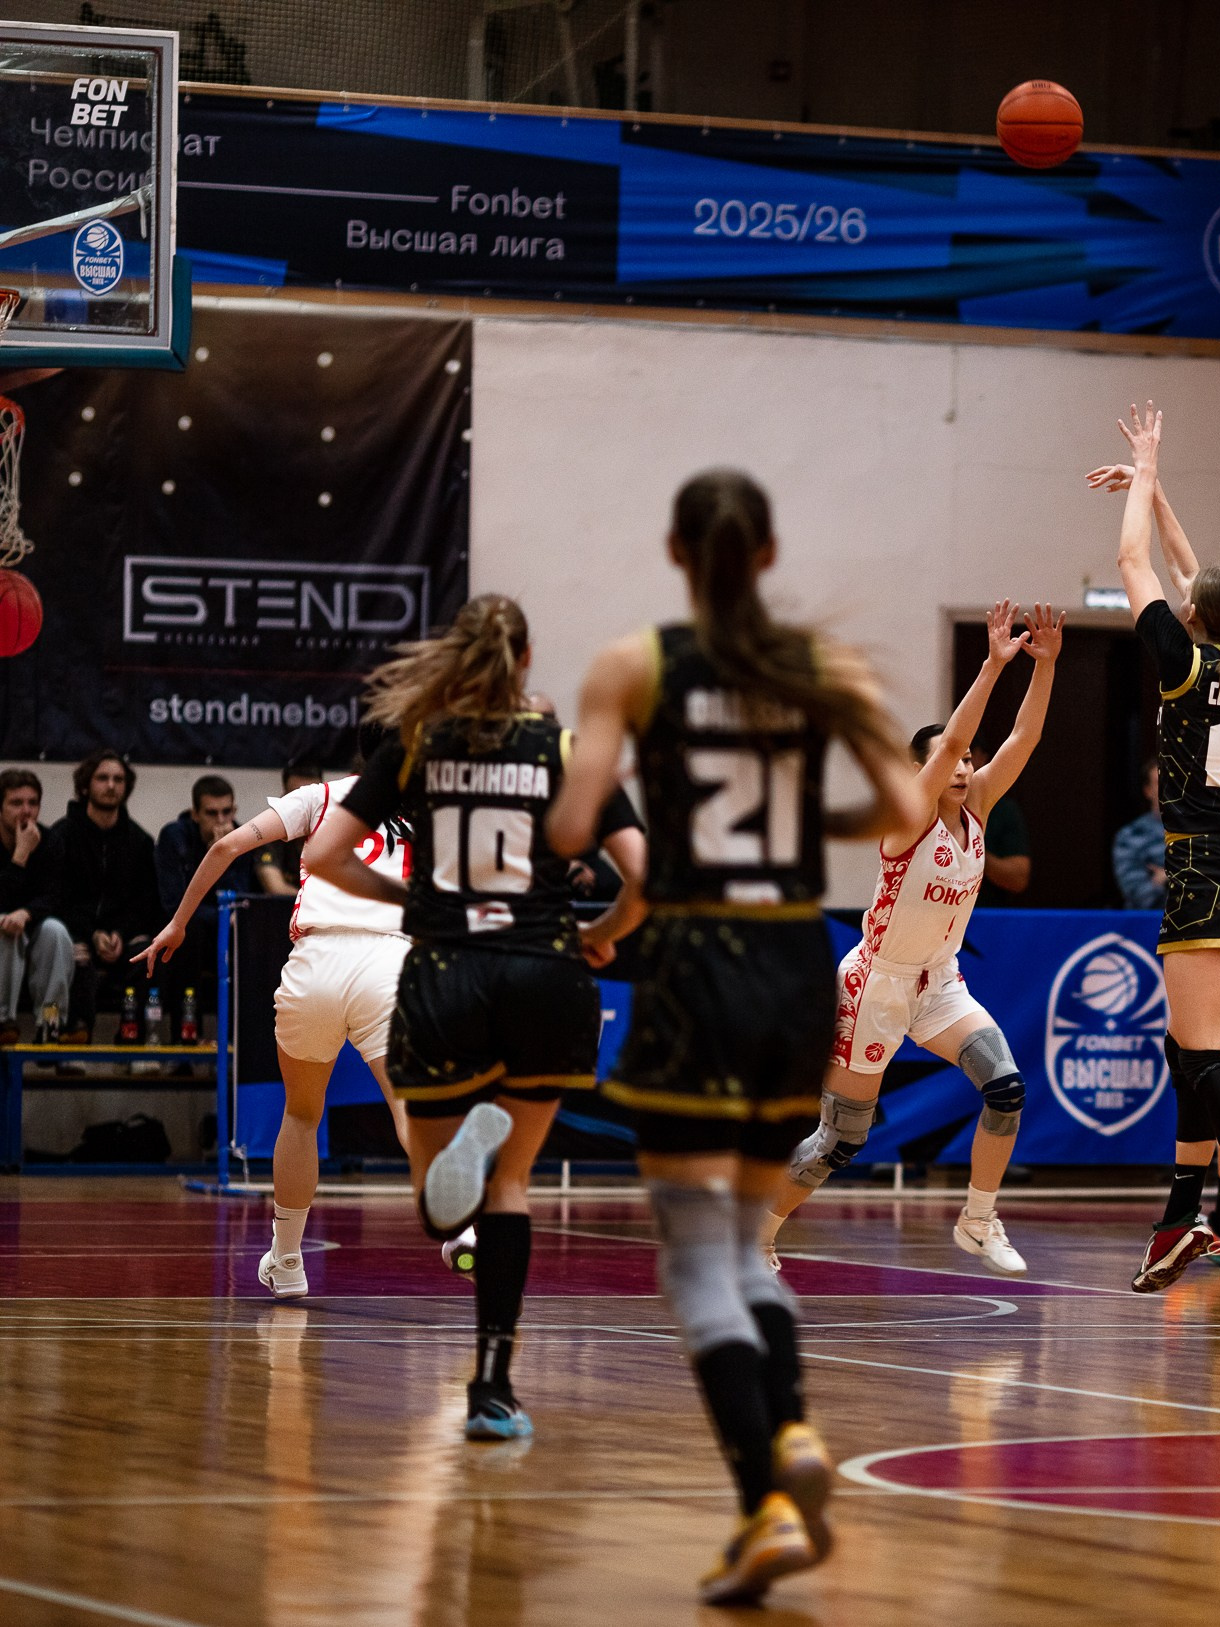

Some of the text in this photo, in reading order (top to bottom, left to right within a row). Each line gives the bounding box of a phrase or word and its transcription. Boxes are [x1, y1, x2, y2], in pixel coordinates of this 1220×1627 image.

[70, 78, 129, 102] FON
[70, 103, 128, 127] BET
[30, 117, 222, 157] Чемпиоат
[451, 185, 566, 220] Fonbet
[694, 198, 867, 244] 2025/26
[346, 220, 566, 260] Высшая лига
[80, 264, 117, 278] ВЫСШАЯ
[141, 575, 416, 633] STEND
[150, 693, 359, 728] stendmebel
[425, 760, 550, 799] КОСИНОВА
[686, 750, 804, 867] 21
[432, 806, 534, 894] 10
[1063, 1058, 1155, 1090] ВЫСШАЯ
